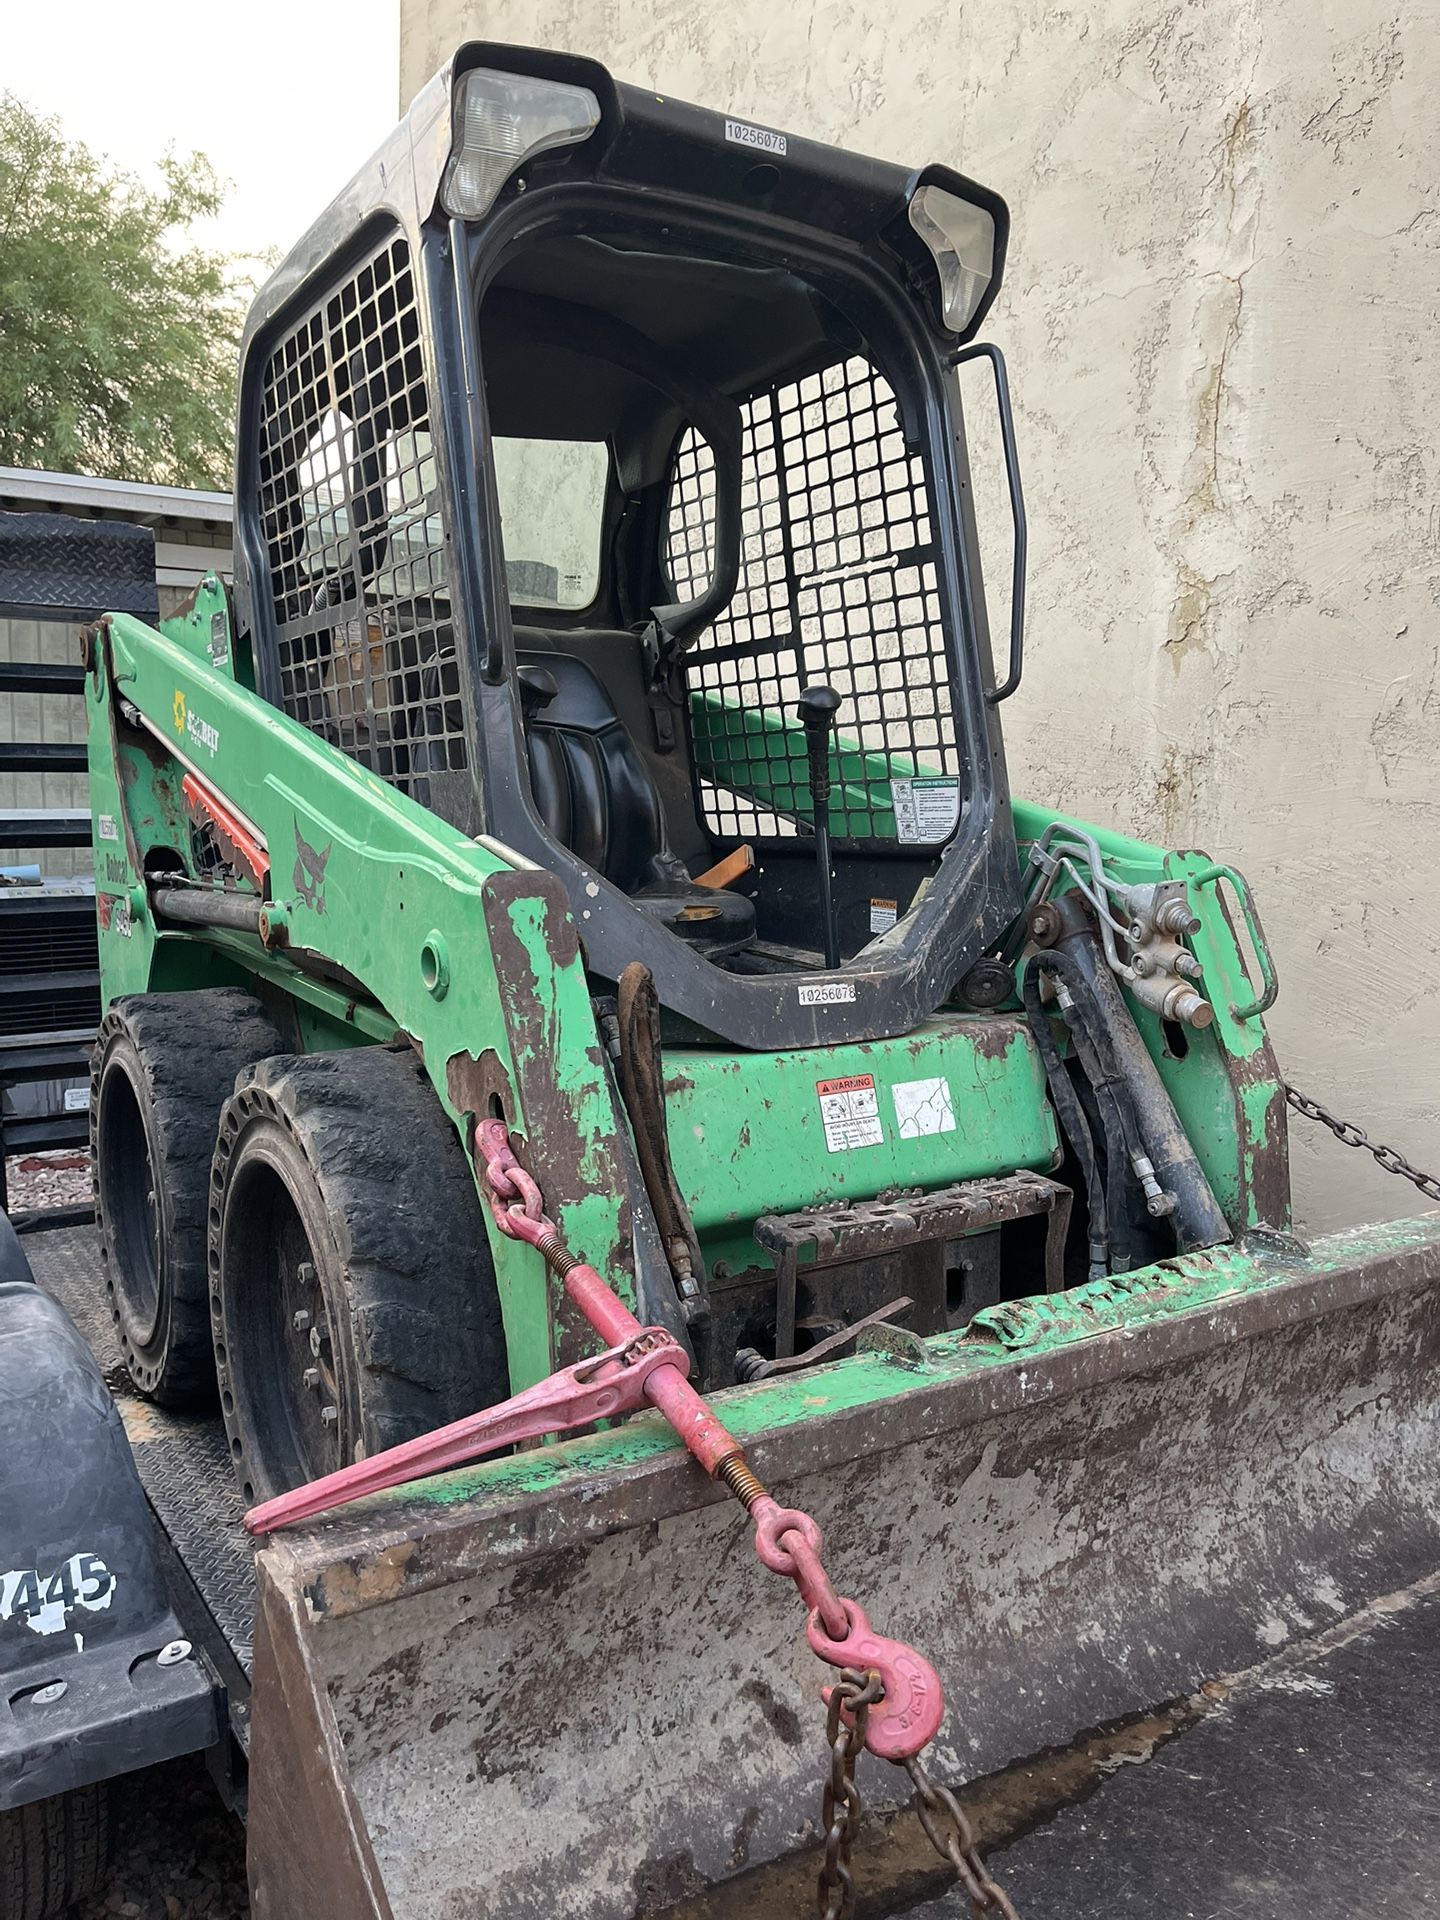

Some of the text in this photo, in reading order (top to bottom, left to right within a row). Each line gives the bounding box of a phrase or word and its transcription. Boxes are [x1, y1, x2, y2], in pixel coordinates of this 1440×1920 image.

[727, 124, 786, 151] 10256078
[800, 987, 856, 1003] 10256078
[830, 1078, 871, 1091] WARNING
[0, 1555, 111, 1617] 445
